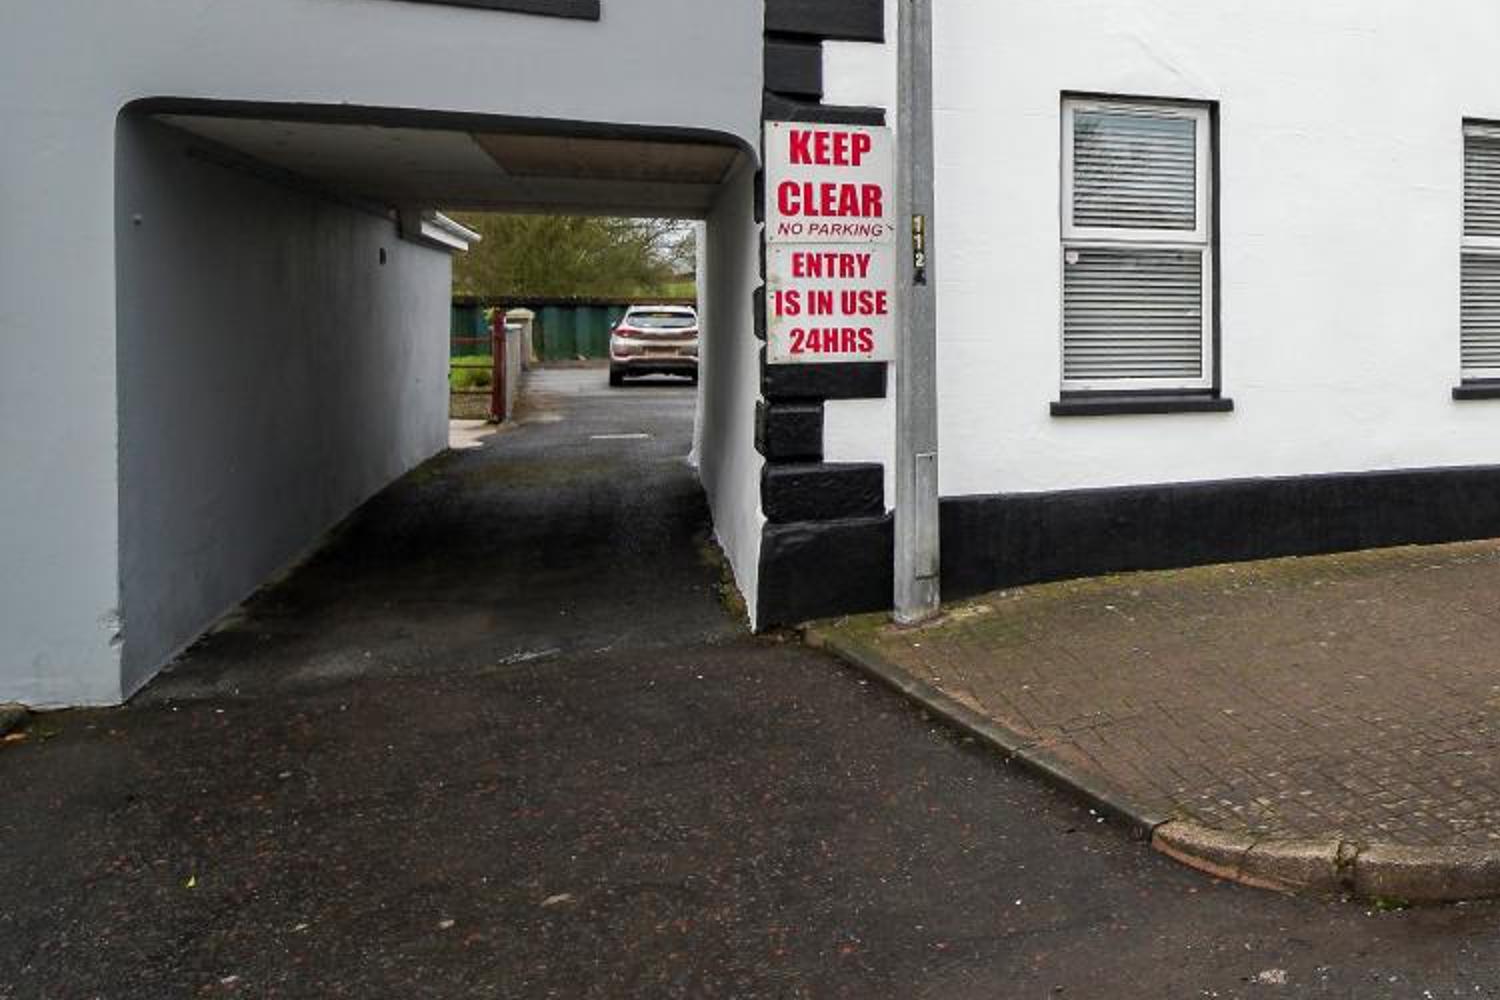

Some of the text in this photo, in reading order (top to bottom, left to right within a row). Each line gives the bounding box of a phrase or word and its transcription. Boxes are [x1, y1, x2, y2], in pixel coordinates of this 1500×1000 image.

[789, 130, 871, 166] KEEP
[777, 181, 883, 218] CLEAR
[777, 222, 884, 237] NO PARKING
[791, 253, 871, 278] ENTRY
[775, 290, 888, 316] IS IN USE
[789, 328, 874, 354] 24HRS
